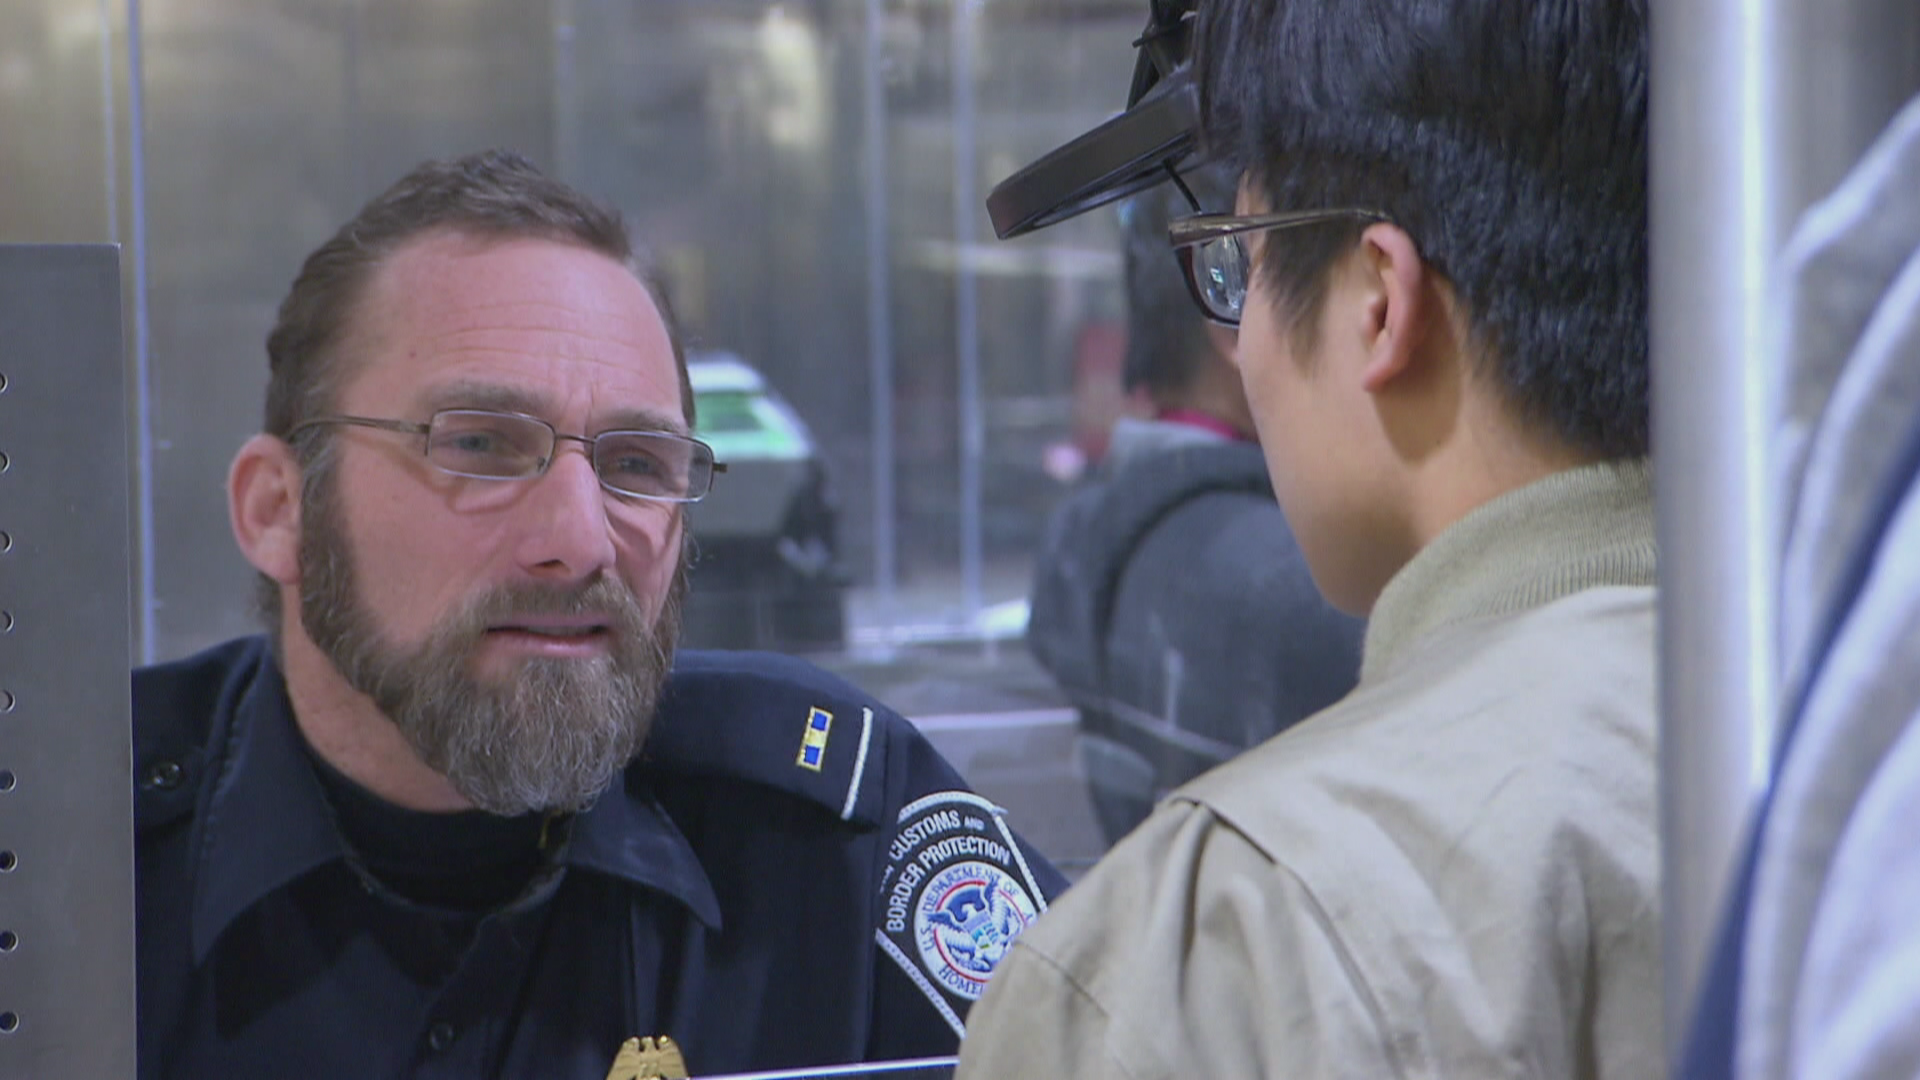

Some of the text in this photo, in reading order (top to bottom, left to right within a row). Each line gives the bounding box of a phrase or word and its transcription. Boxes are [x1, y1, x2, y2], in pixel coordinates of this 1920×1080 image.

[889, 809, 985, 861] CUSTOMS AND
[886, 862, 925, 932] BORDER
[919, 836, 1011, 870] PROTECTION
[922, 865, 1001, 912] DEPARTMENT
[1003, 881, 1018, 896] OF
